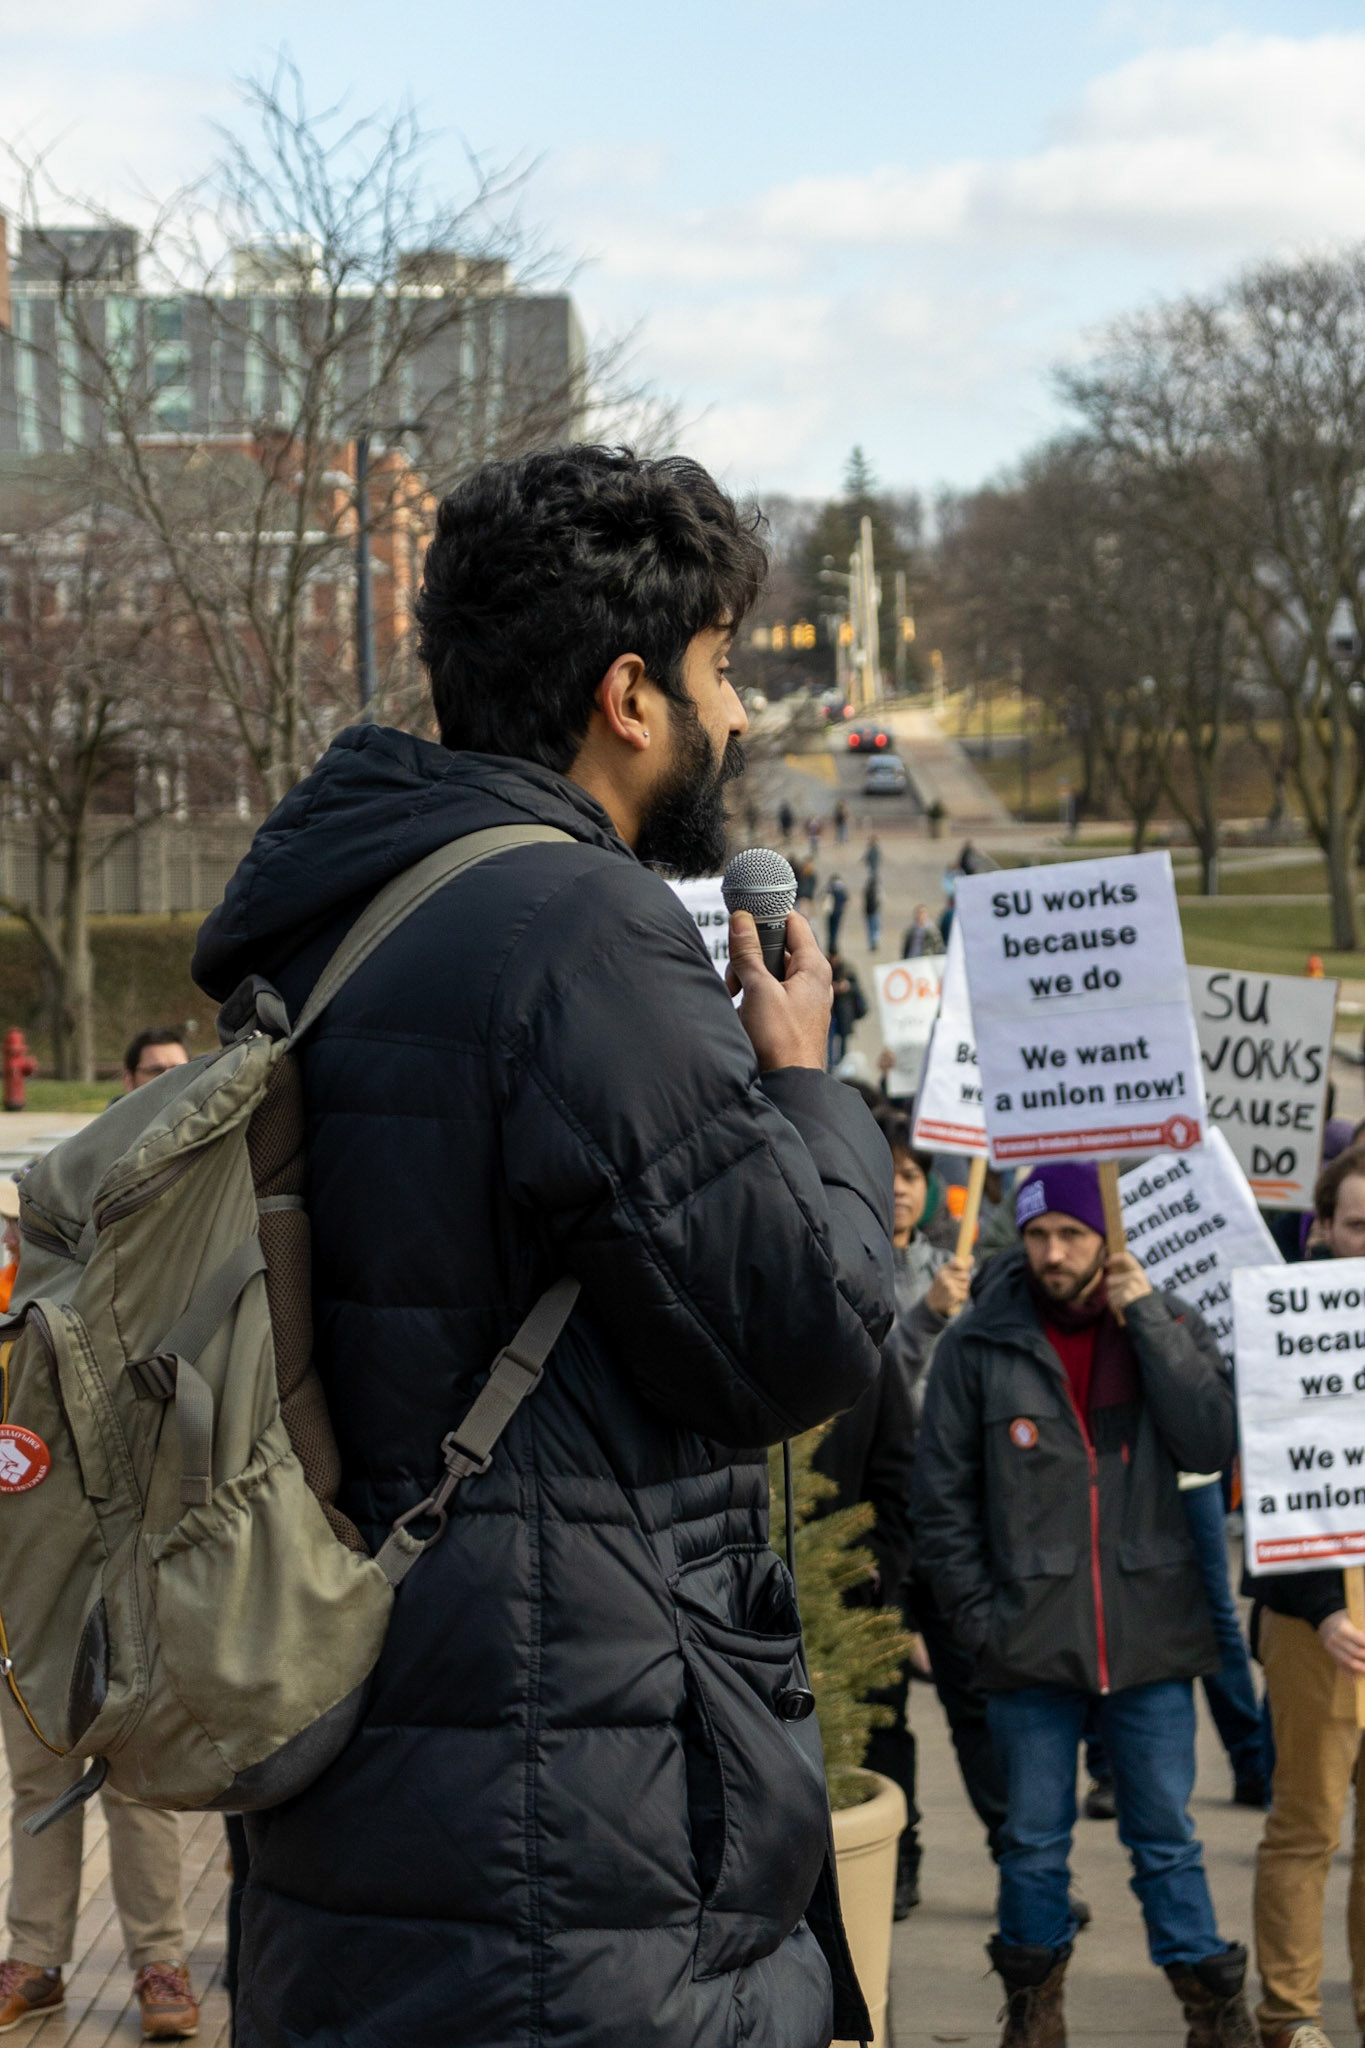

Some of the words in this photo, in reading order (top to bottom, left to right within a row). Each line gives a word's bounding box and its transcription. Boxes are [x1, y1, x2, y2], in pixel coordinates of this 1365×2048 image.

[992, 888, 1032, 918] SU
[1043, 880, 1138, 912] works
[1003, 925, 1137, 959] because
[1029, 974, 1074, 998] we
[1083, 964, 1122, 991] do
[1202, 972, 1270, 1025] SU
[1020, 1045, 1068, 1071] We
[1076, 1035, 1150, 1065] want
[995, 1092, 1012, 1112] a
[1022, 1080, 1106, 1109] union
[1114, 1071, 1187, 1103] now!
[1253, 1145, 1297, 1176] DO
[1267, 1287, 1308, 1315] SU
[1300, 1373, 1343, 1398] we
[1288, 1445, 1334, 1472] We
[1259, 1494, 1276, 1515] a
